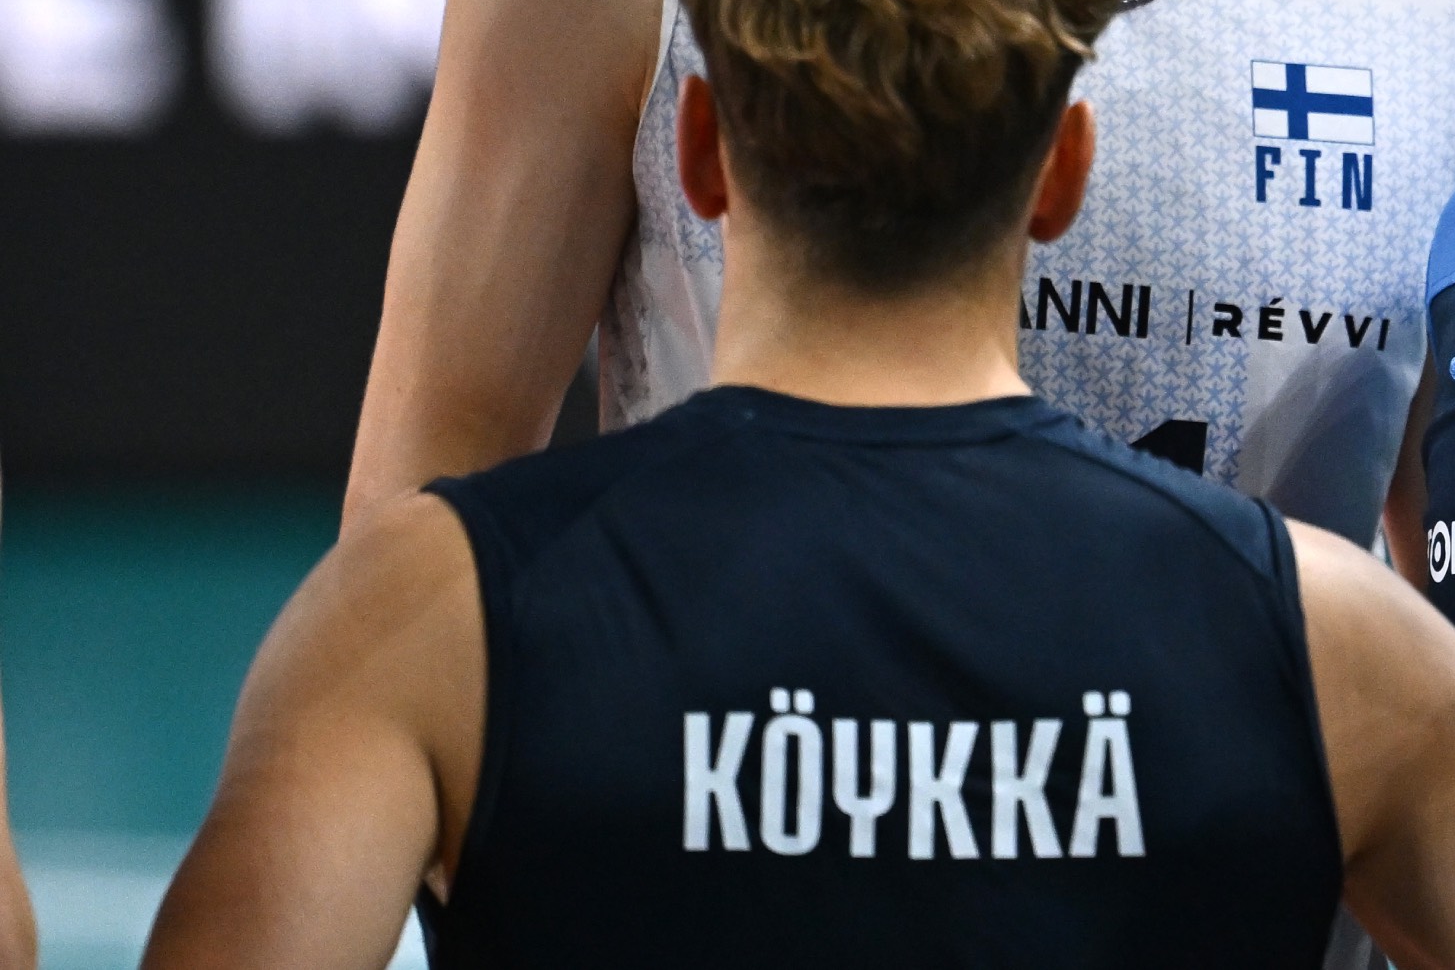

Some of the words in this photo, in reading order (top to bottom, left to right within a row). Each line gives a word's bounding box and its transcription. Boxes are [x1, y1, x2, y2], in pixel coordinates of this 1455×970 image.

[1255, 145, 1373, 212] FIN
[1020, 277, 1152, 339] NNI
[1211, 297, 1391, 352] RÉVVI
[682, 686, 1147, 860] KÖYKKÄ
